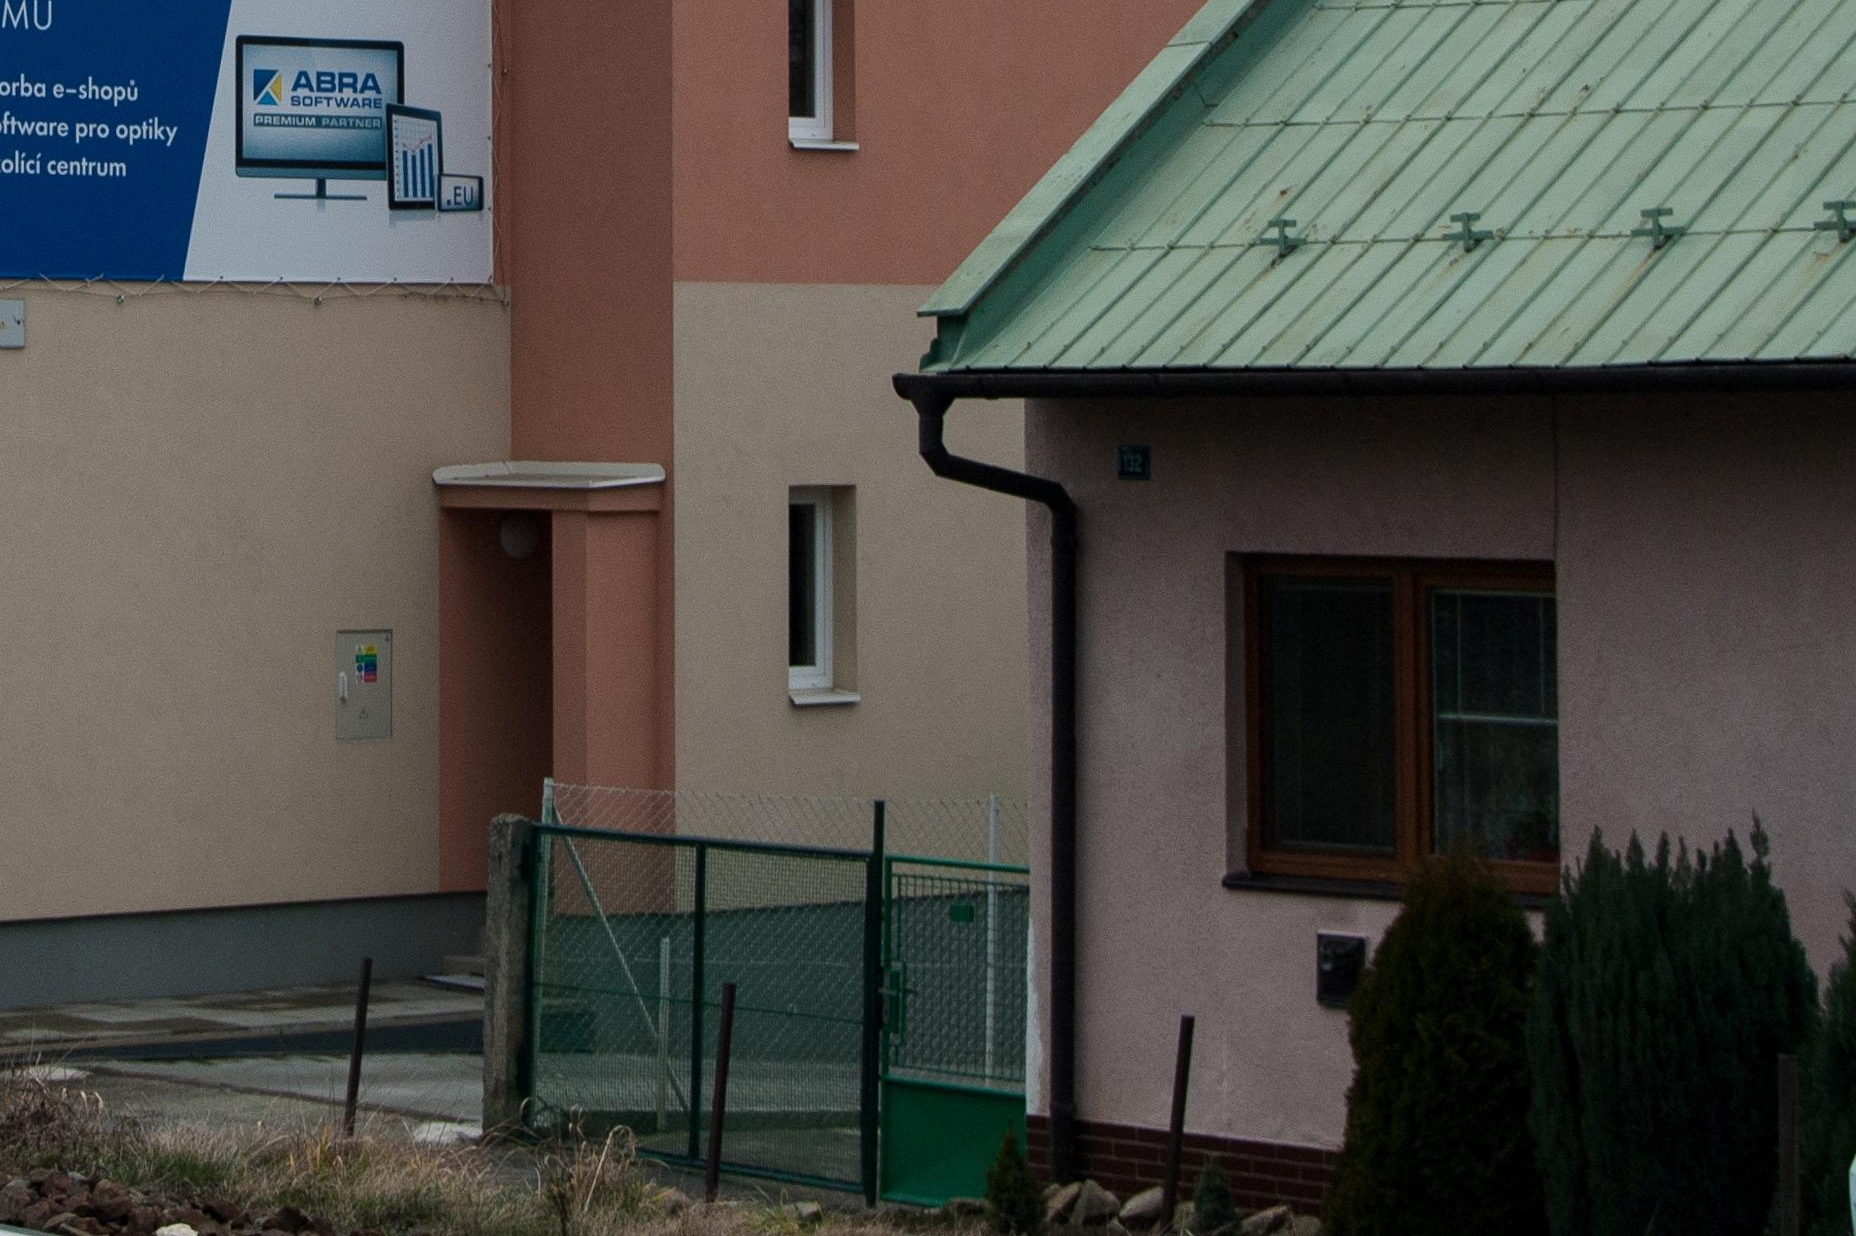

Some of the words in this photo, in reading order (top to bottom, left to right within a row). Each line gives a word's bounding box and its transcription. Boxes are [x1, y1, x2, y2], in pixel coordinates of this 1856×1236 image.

[291, 70, 382, 95] ABRA
[291, 95, 383, 110] SOFTWARE
[75, 122, 110, 144] pro
[115, 117, 179, 148] optiky
[255, 115, 316, 127] PREMIUM
[321, 117, 381, 129] PARTNER
[47, 156, 127, 177] centrum
[446, 185, 474, 207] .EU
